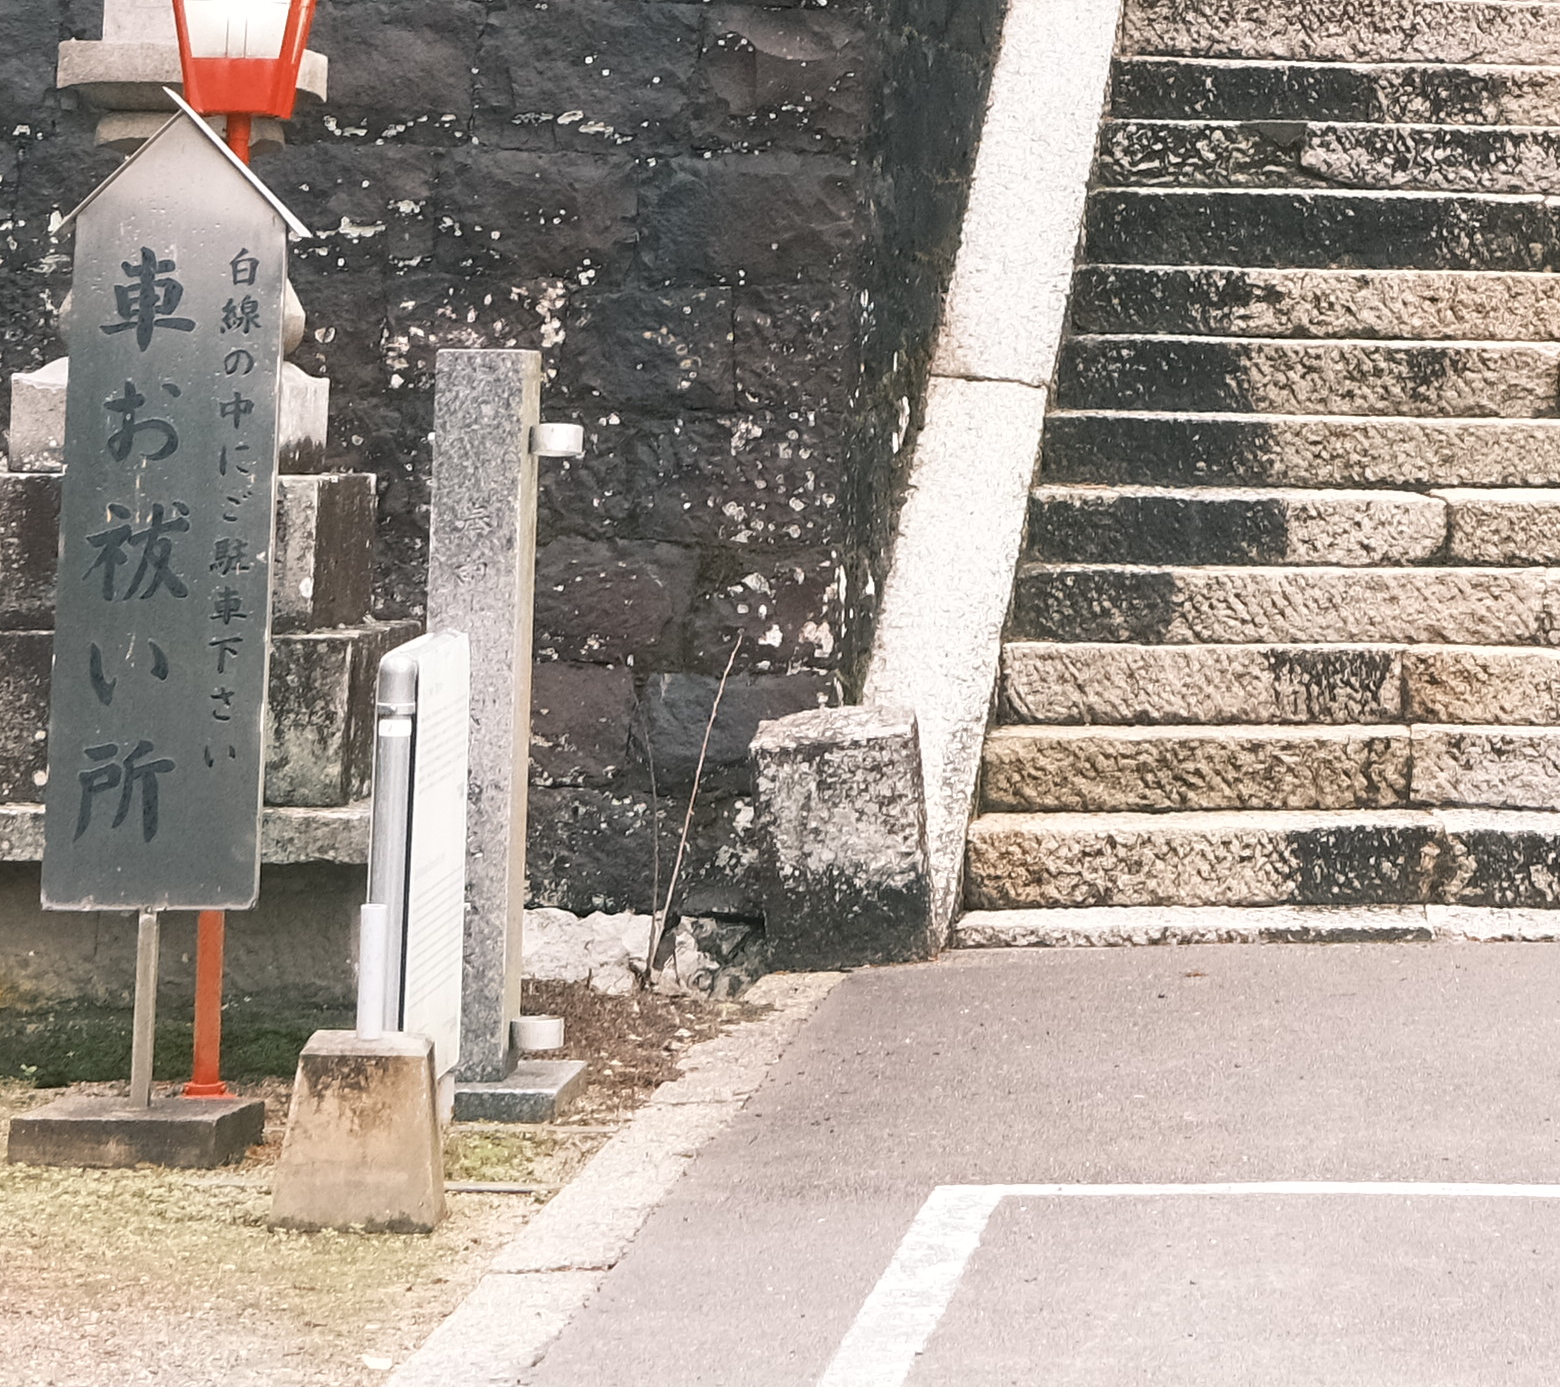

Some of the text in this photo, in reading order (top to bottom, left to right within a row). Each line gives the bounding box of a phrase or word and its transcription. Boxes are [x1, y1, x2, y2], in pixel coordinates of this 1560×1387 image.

[73, 245, 197, 843] 車お祓い所
[201, 246, 263, 771] 白線の中にご駐車下さい
